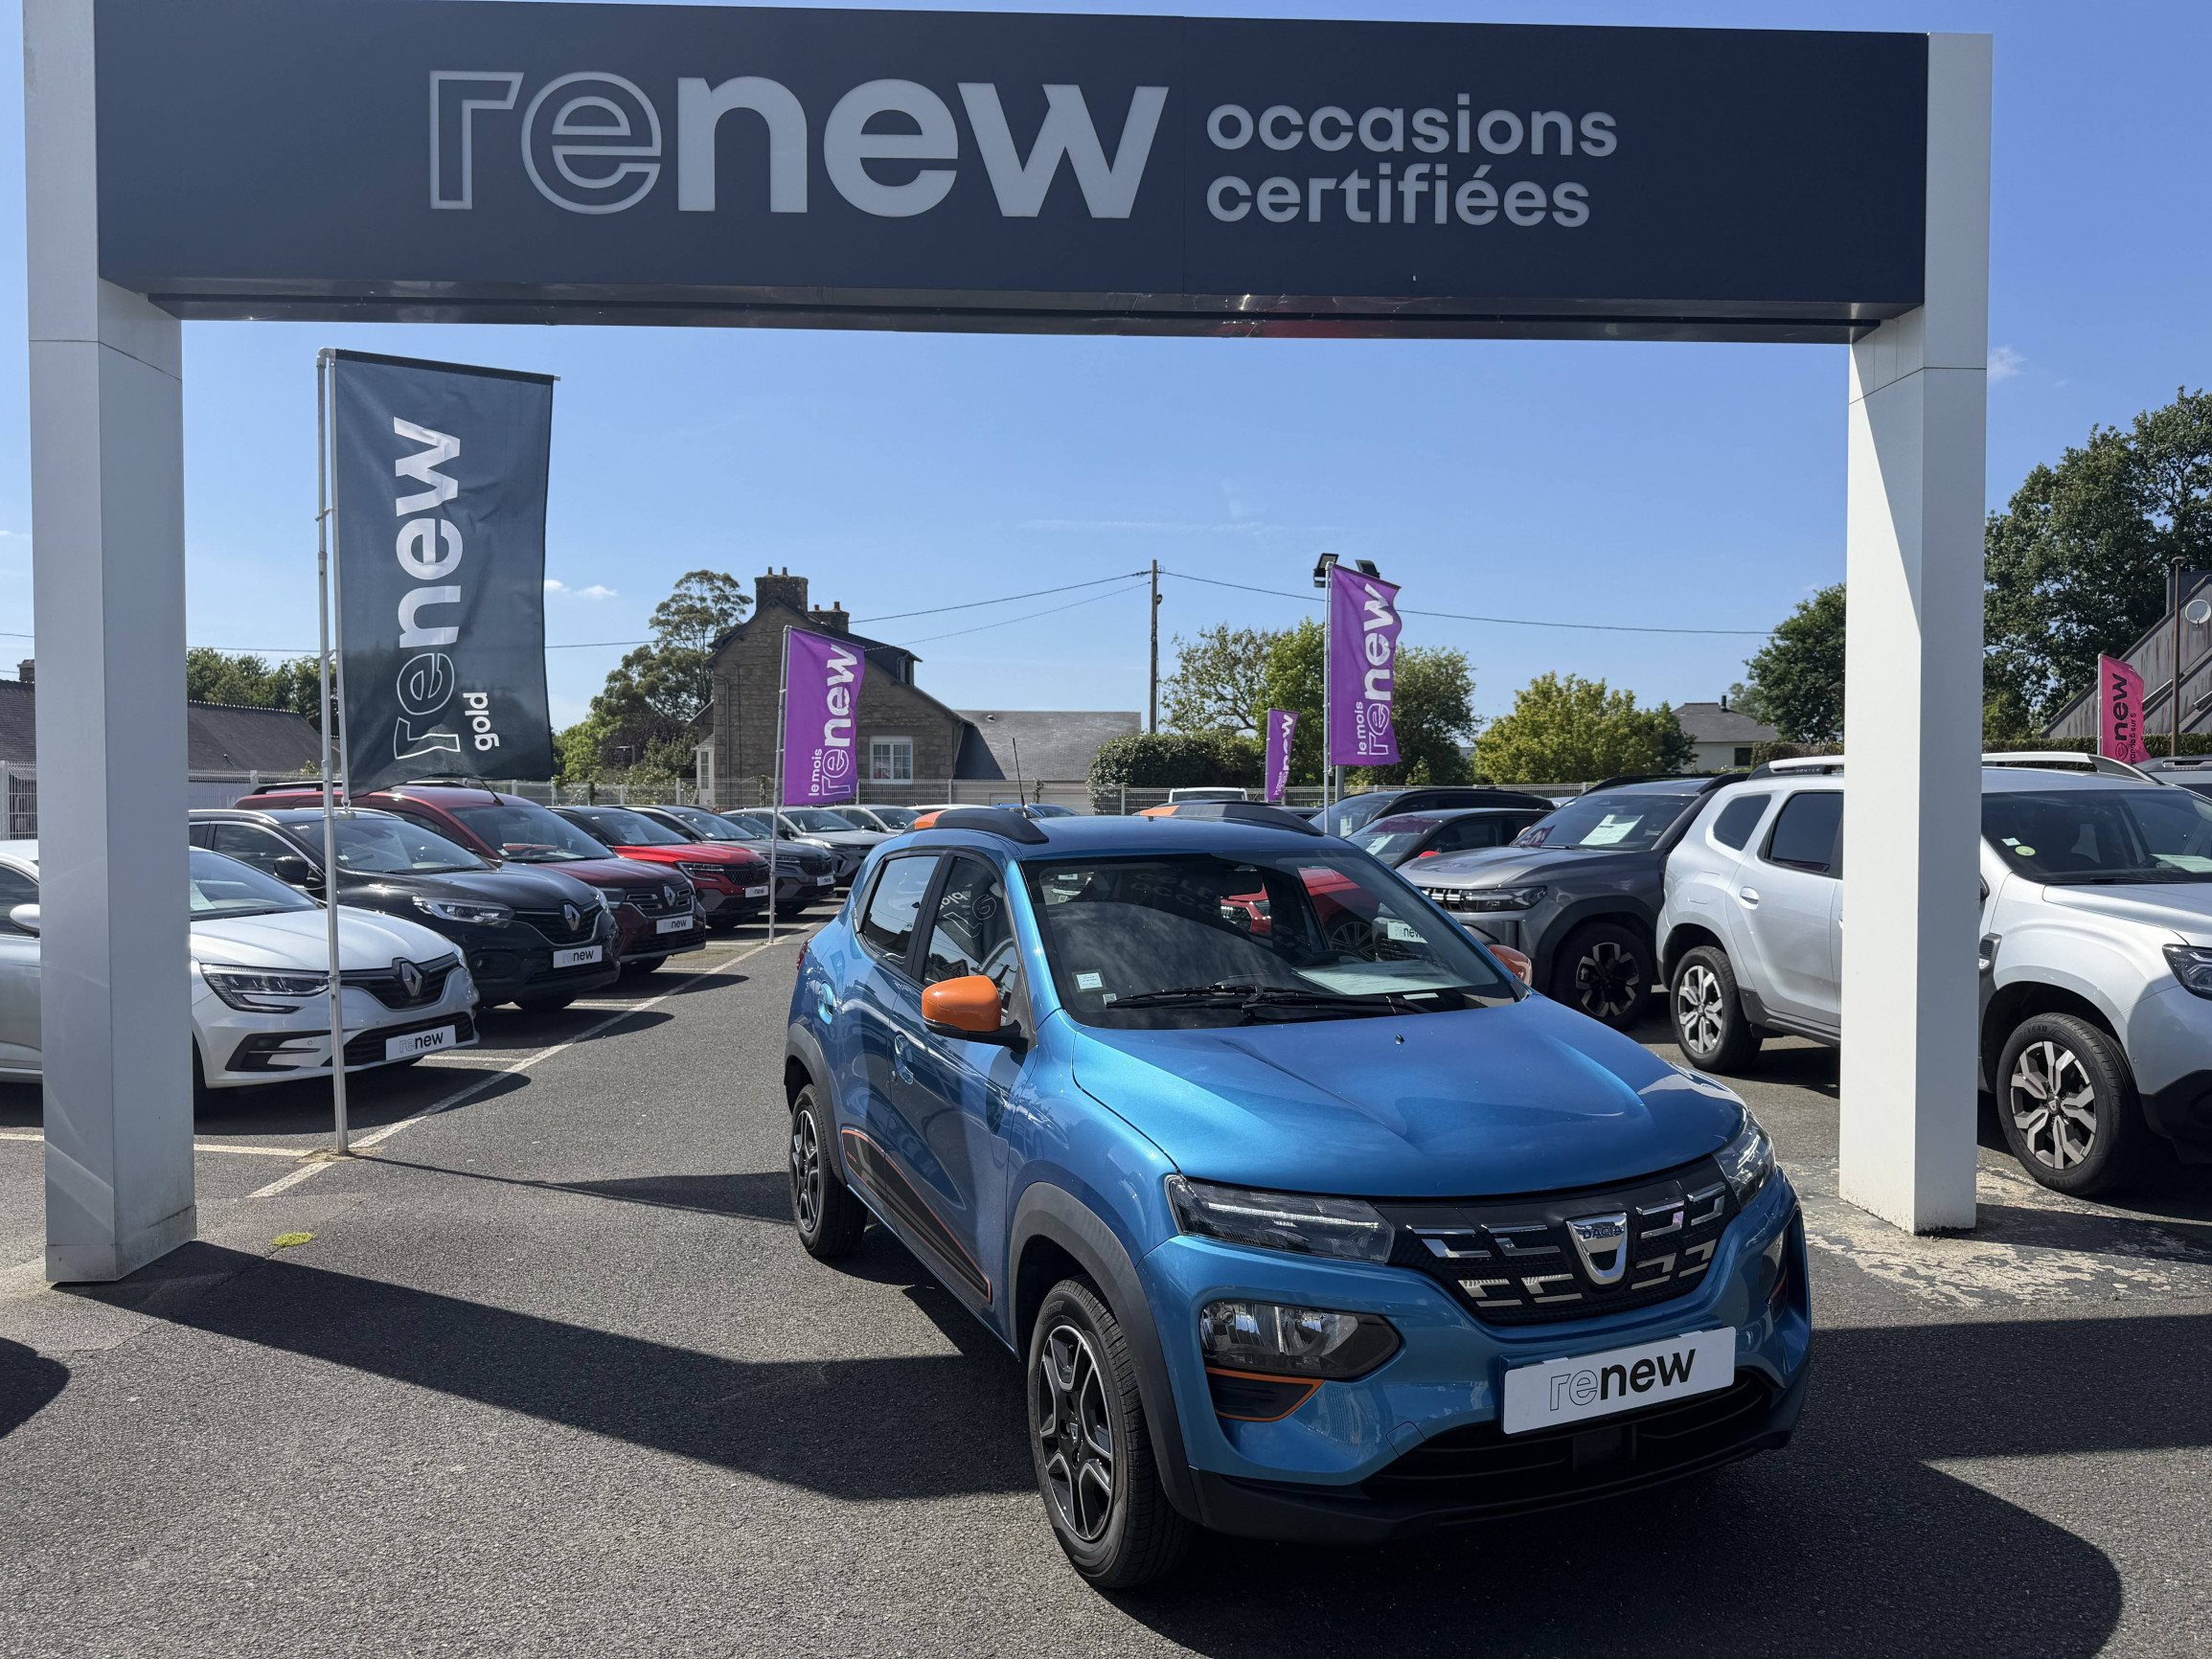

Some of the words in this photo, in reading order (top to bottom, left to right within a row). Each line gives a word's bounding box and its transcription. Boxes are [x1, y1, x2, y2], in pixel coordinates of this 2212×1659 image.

[429, 70, 1170, 218] renew
[1206, 93, 1618, 157] occasions
[1206, 162, 1590, 228] certifiées
[393, 416, 464, 761] renew
[1363, 583, 1395, 756] renew
[462, 691, 500, 752] gold
[822, 644, 858, 796] renew
[1354, 701, 1367, 740] mois
[2112, 672, 2129, 761] enew
[811, 748, 823, 782] mois
[1357, 743, 1367, 756] le
[809, 784, 820, 796] le
[399, 1032, 444, 1053] renew
[1583, 1225, 1624, 1239] DACIA
[1549, 1348, 1697, 1412] renew
